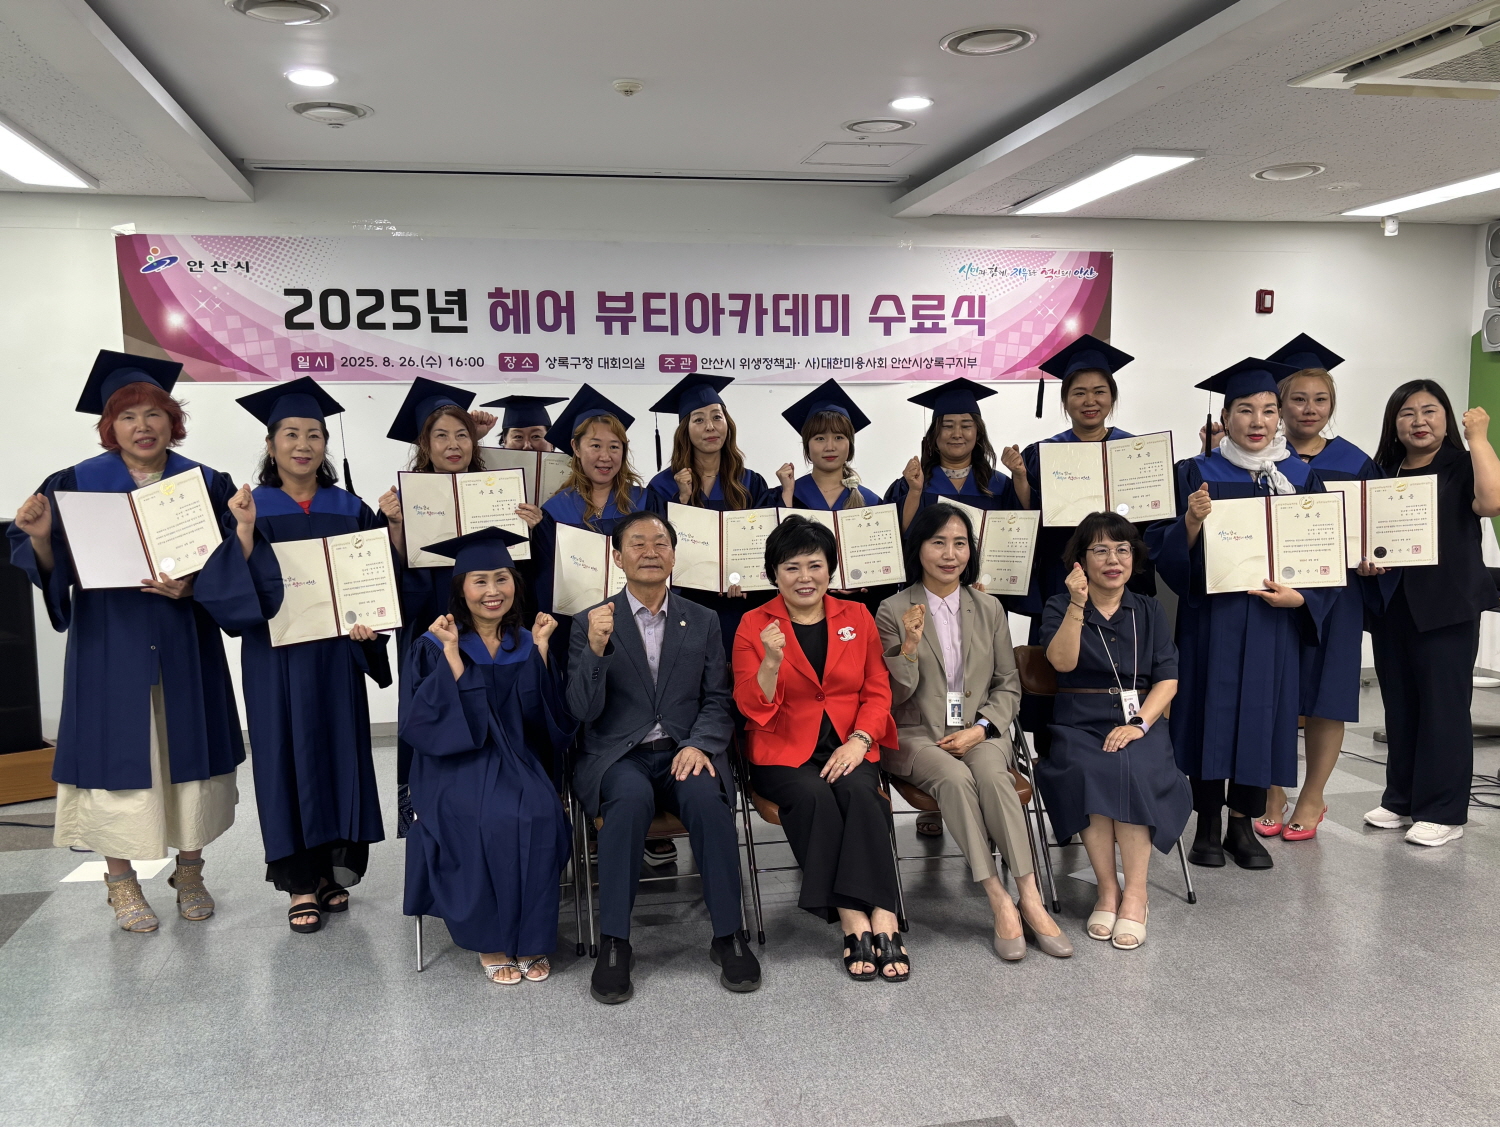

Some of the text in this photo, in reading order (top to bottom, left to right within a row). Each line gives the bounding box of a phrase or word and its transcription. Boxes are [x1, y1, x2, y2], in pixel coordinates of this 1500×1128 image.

[186, 259, 250, 273] 안산시
[1073, 267, 1099, 279] 안산
[283, 287, 987, 337] 2025년 헤어 뷰티아카데미 수료식
[296, 355, 329, 369] 일시
[340, 356, 379, 369] 2025.
[382, 356, 395, 368] 8.
[399, 355, 443, 370] 26.(수)
[448, 355, 485, 368] 16:00
[503, 355, 534, 370] 장소
[545, 356, 594, 370] 상록구청
[598, 356, 645, 370] 대회의실
[664, 357, 692, 371] 주관
[701, 357, 736, 370] 안산시
[804, 356, 888, 371] 사)대한미용사회
[891, 356, 978, 370] 안산시상록구지부
